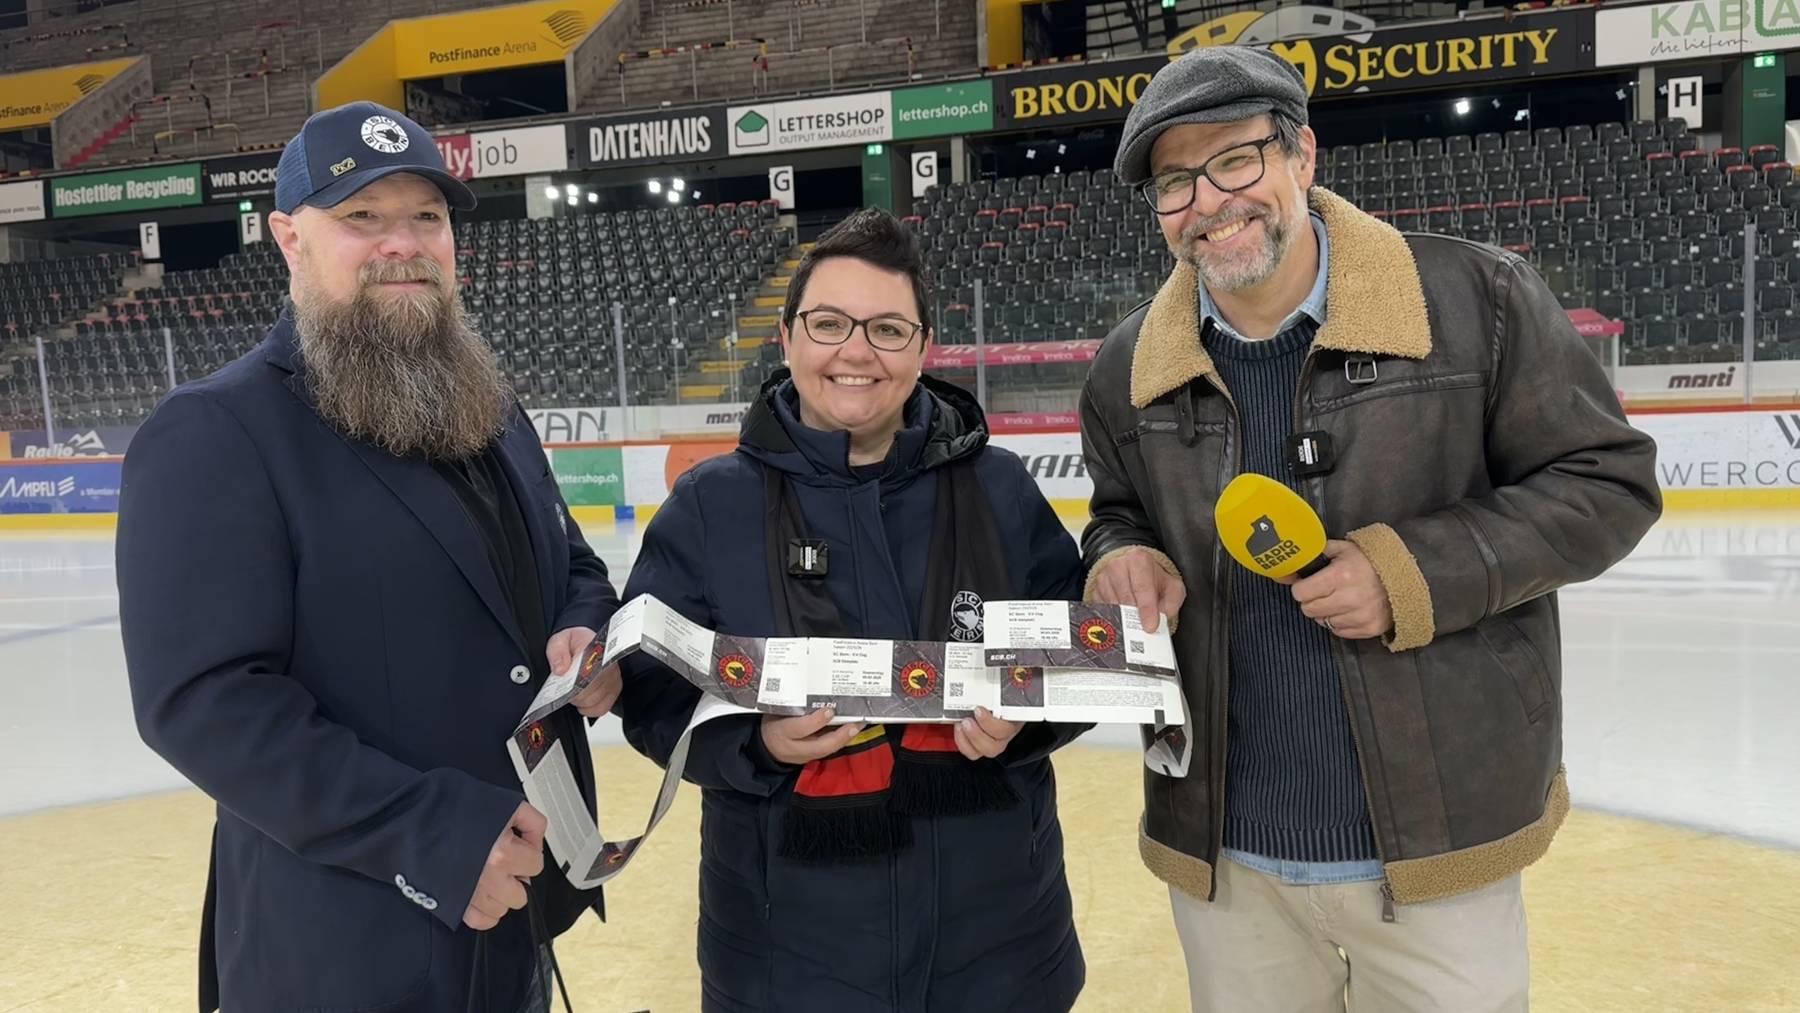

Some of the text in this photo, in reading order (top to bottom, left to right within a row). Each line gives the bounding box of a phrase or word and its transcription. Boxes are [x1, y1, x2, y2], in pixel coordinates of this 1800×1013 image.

[429, 40, 537, 63] PostFinance Arena
[1325, 29, 1557, 89] SECURITY
[1651, 41, 1678, 56] die
[1675, 81, 1697, 108] H
[779, 108, 884, 132] LETTERSHOP
[899, 100, 988, 121] lettershop.ch
[589, 116, 711, 162] DATENHAUS
[779, 126, 885, 145] OUTPUT MANAGEMENT
[916, 156, 933, 177] G
[210, 172, 237, 188] WIR
[774, 170, 790, 192] G
[55, 176, 195, 207] Hostettler Recycling
[145, 225, 154, 245] F
[247, 216, 255, 234] F
[1668, 366, 1735, 388] marti
[706, 406, 748, 424] mart
[24, 443, 73, 458] Radio
[556, 472, 618, 485] lettershop.ch
[1254, 540, 1294, 564] RADIO
[956, 593, 978, 604] SC
